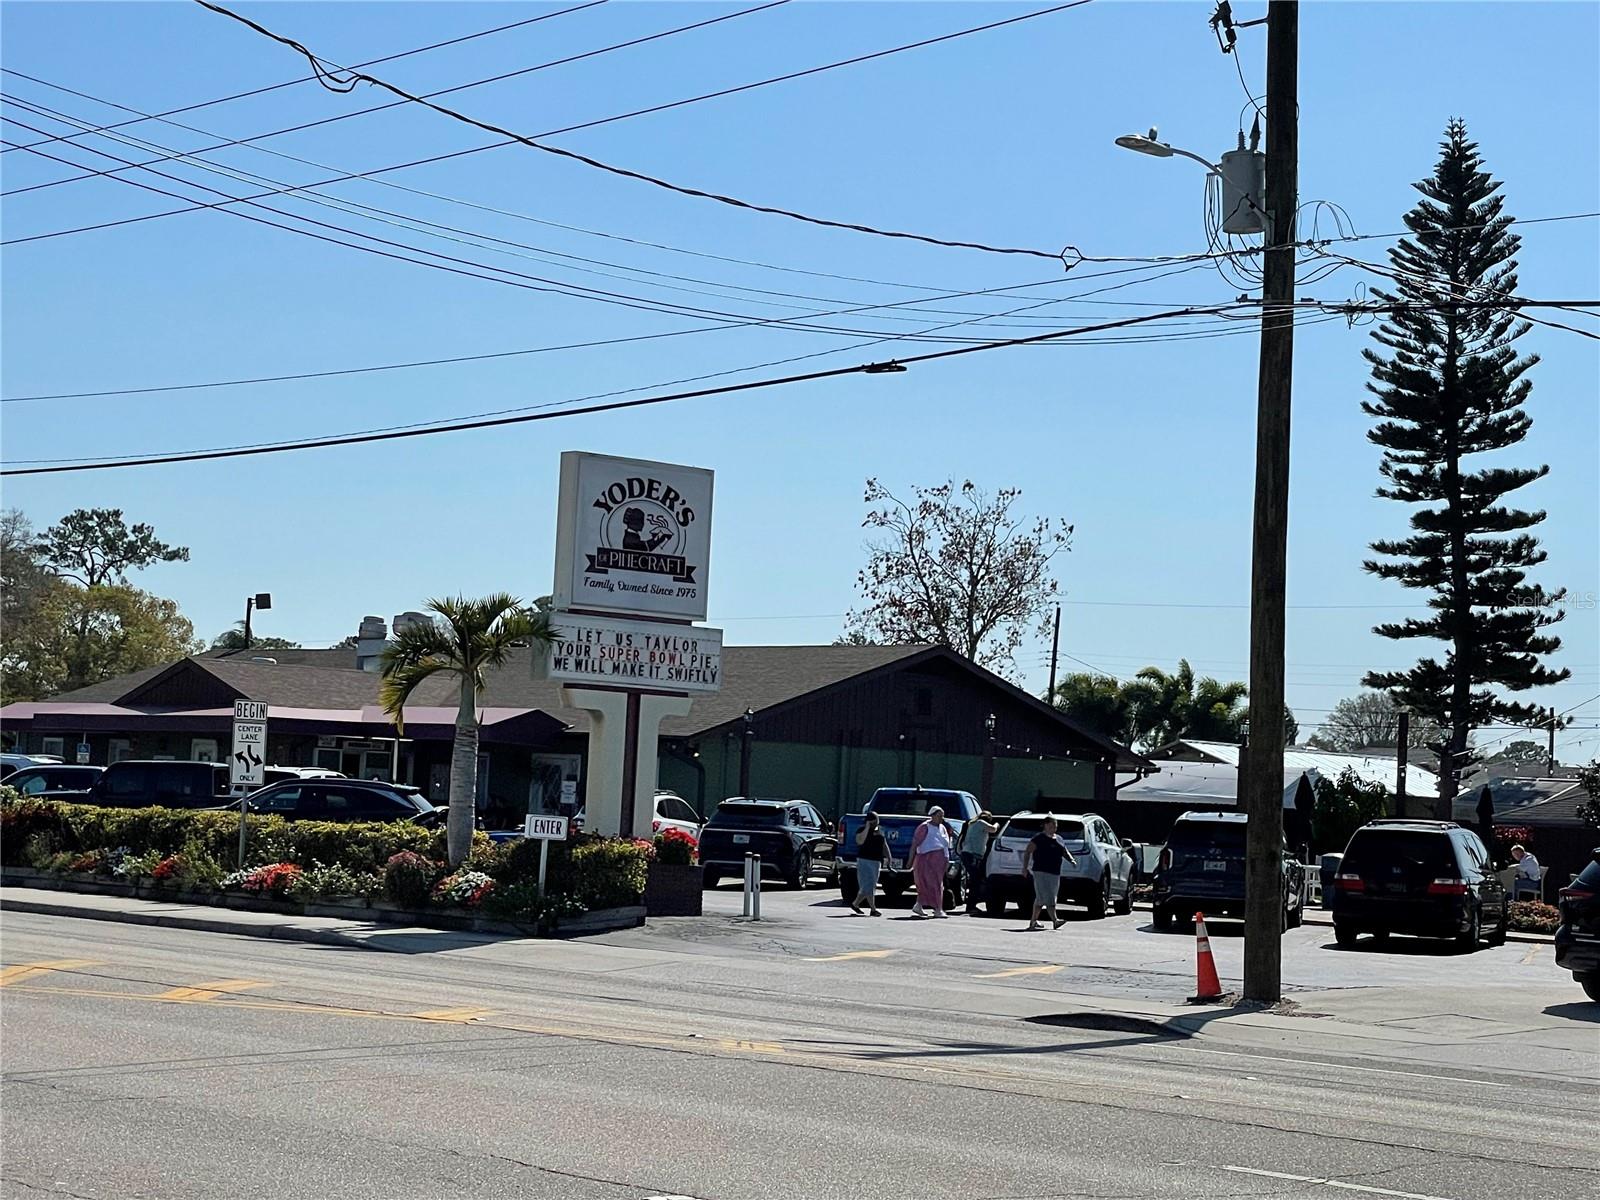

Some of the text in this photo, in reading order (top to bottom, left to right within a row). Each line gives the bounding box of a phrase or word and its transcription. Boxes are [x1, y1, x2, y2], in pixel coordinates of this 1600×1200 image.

[593, 478, 695, 527] YODER'S
[610, 551, 683, 574] PINECRAFT
[584, 577, 697, 599] Family Owned Since 1975
[577, 629, 698, 653] LET US TAYLOR
[558, 642, 591, 657] YOUR
[600, 646, 640, 663] SUPER
[650, 650, 685, 666] BOWL
[553, 657, 718, 684] WE WILL MAKE IT SWIFTLY
[236, 702, 266, 718] BEGIN
[238, 725, 262, 733] CENTER
[241, 733, 258, 741] LANE
[239, 774, 256, 782] ONLY
[534, 819, 562, 835] ENTER
